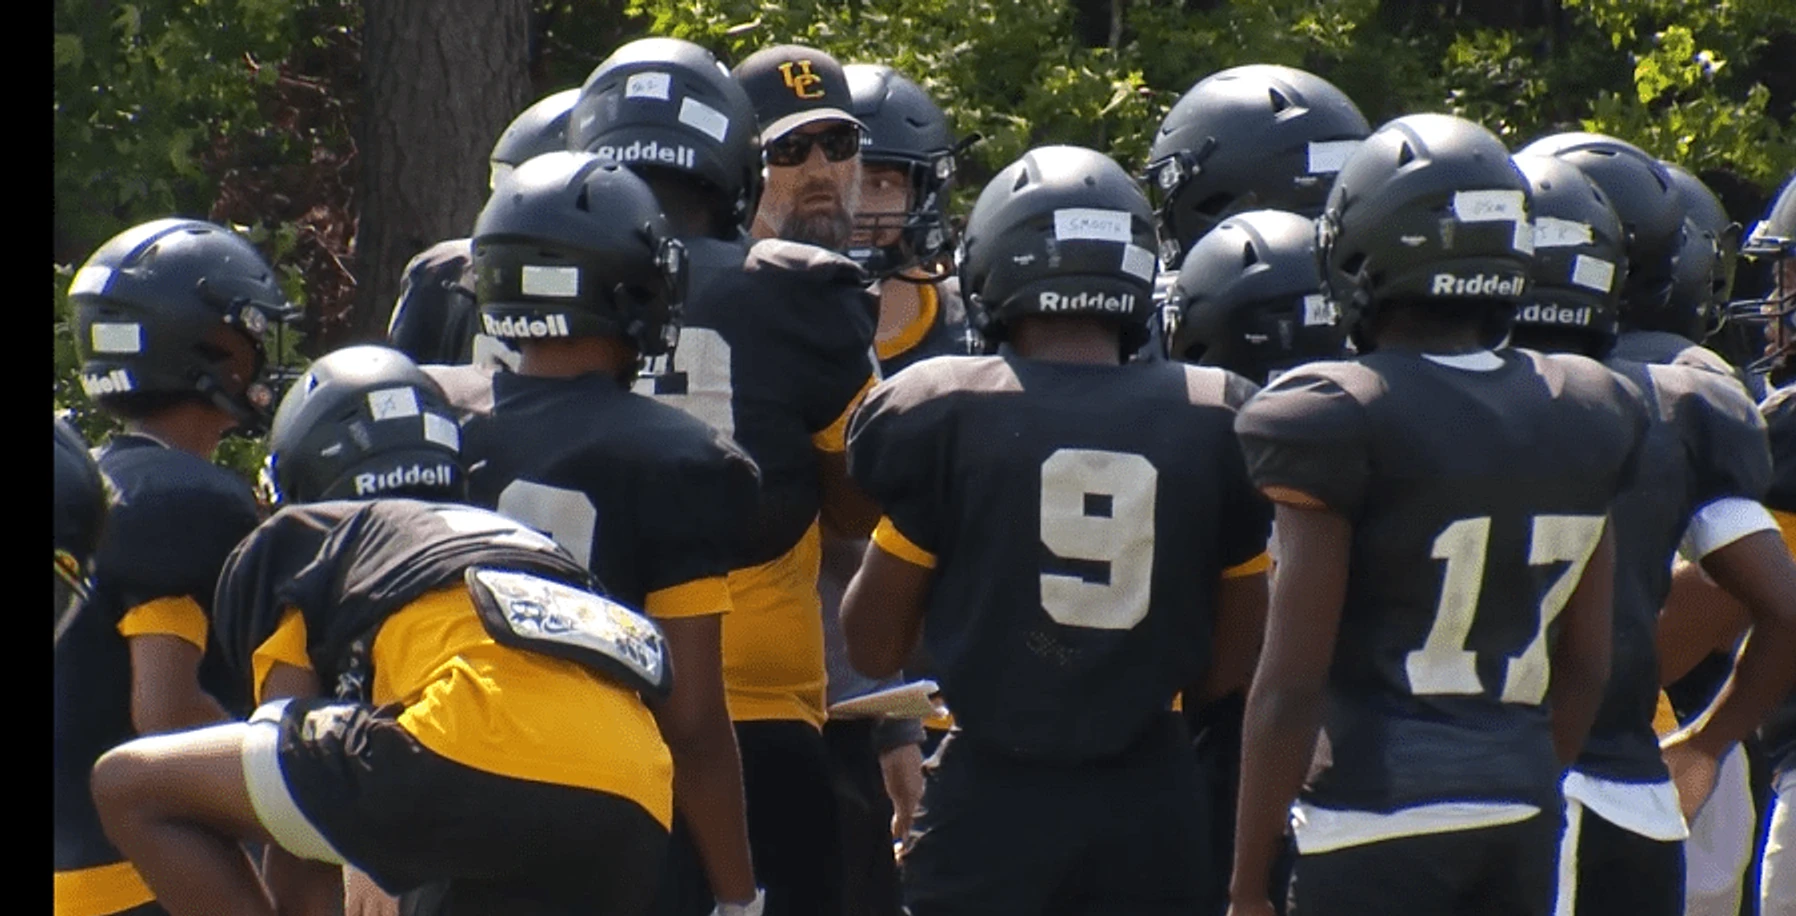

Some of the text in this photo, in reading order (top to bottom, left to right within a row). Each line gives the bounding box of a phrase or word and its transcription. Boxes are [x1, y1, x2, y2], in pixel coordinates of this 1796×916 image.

[778, 60, 826, 99] UC
[1039, 290, 1135, 314] Riddell
[1432, 272, 1525, 297] Riddell
[355, 463, 451, 496] Riddell
[1040, 448, 1158, 630] 9
[1406, 515, 1608, 706] 17
